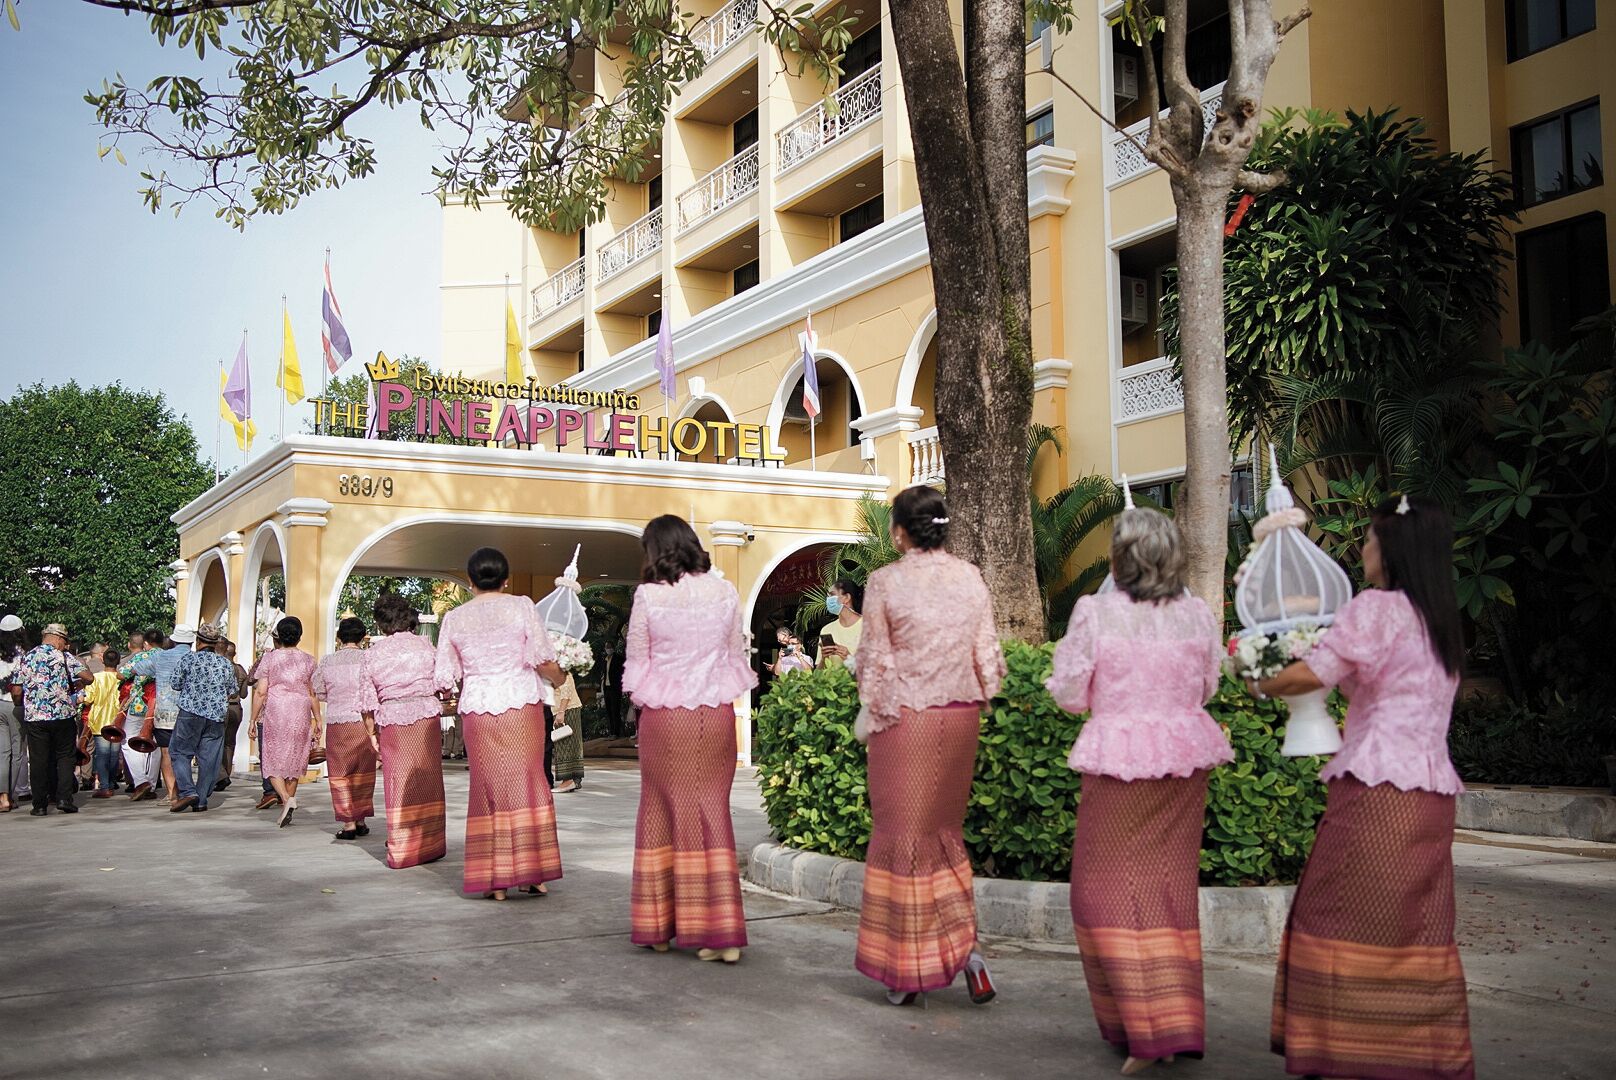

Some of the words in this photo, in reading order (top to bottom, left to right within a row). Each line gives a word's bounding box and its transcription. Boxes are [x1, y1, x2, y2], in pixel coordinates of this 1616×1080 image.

[307, 398, 370, 431] THE
[376, 381, 636, 451] PINEAPPLE
[637, 414, 785, 462] HOTEL
